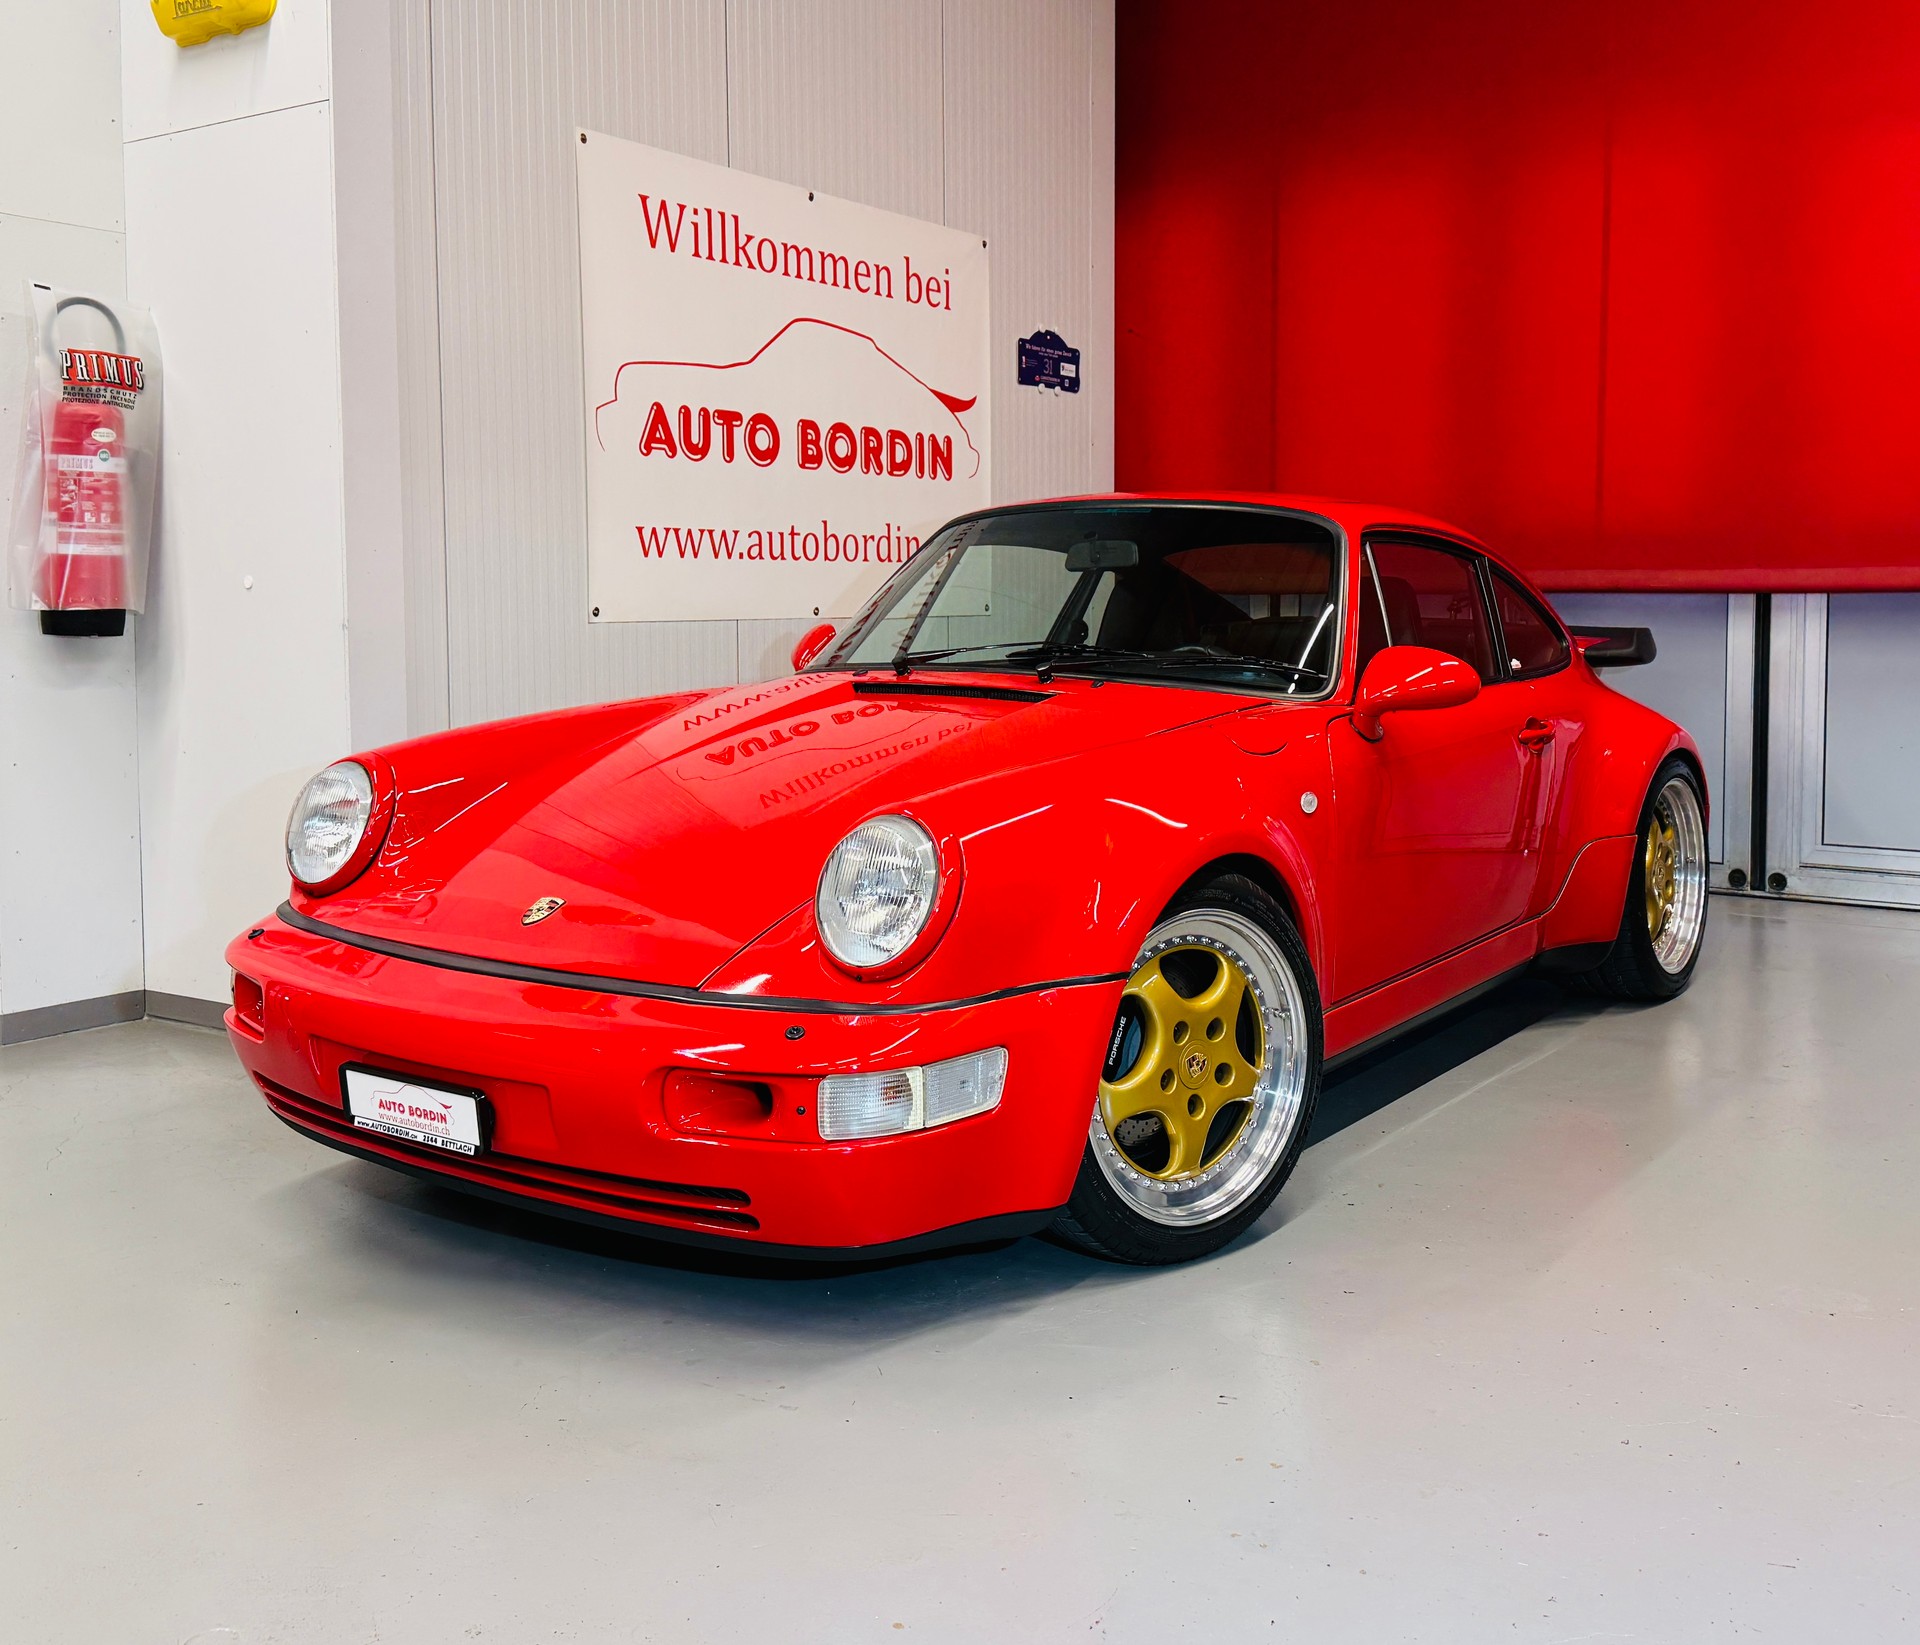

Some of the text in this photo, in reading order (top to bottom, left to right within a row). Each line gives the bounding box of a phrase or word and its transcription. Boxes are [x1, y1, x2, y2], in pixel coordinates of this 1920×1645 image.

[638, 193, 951, 311] Willkommen bei
[60, 350, 144, 390] PRIMUS
[61, 397, 135, 410] PROTEZIONE ANTINCENDIO
[63, 385, 137, 399] BRANDSCHUTZ
[63, 391, 136, 405] PROTECTION INCENDIE
[639, 401, 953, 481] AUTO BORDIN
[635, 520, 920, 563] www.autobordin
[1108, 1015, 1127, 1066] PORSCHE
[378, 1099, 448, 1125] AUTO BORDIN
[378, 1112, 451, 1137] www.autobordin.ch
[441, 1139, 472, 1153] BETTLACH
